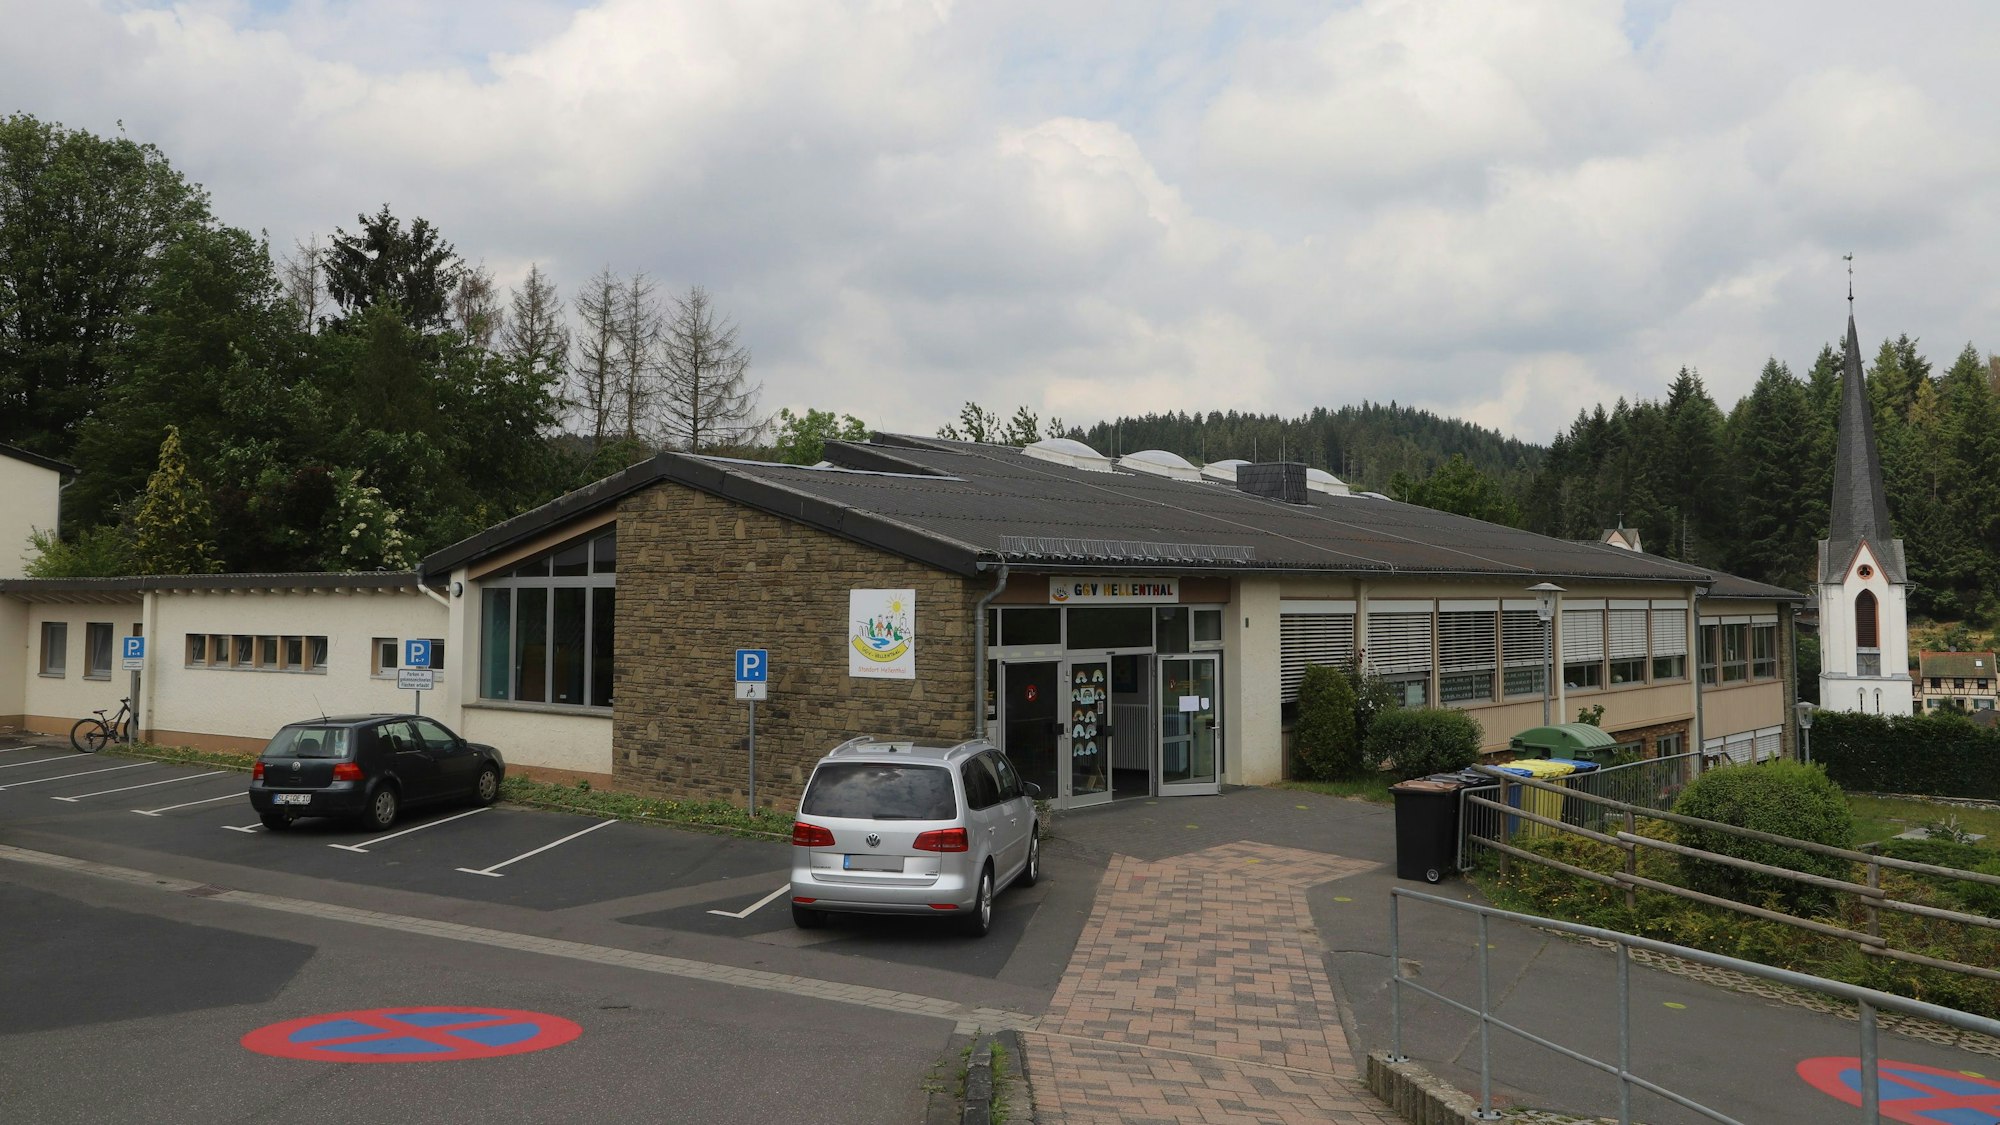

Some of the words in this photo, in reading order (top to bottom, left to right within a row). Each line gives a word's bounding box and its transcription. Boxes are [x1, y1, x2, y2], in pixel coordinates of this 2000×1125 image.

[1074, 583, 1098, 596] GGV
[1103, 583, 1173, 596] HELLENTHAL
[127, 639, 140, 656] P
[410, 643, 425, 663] P
[743, 653, 760, 678] P
